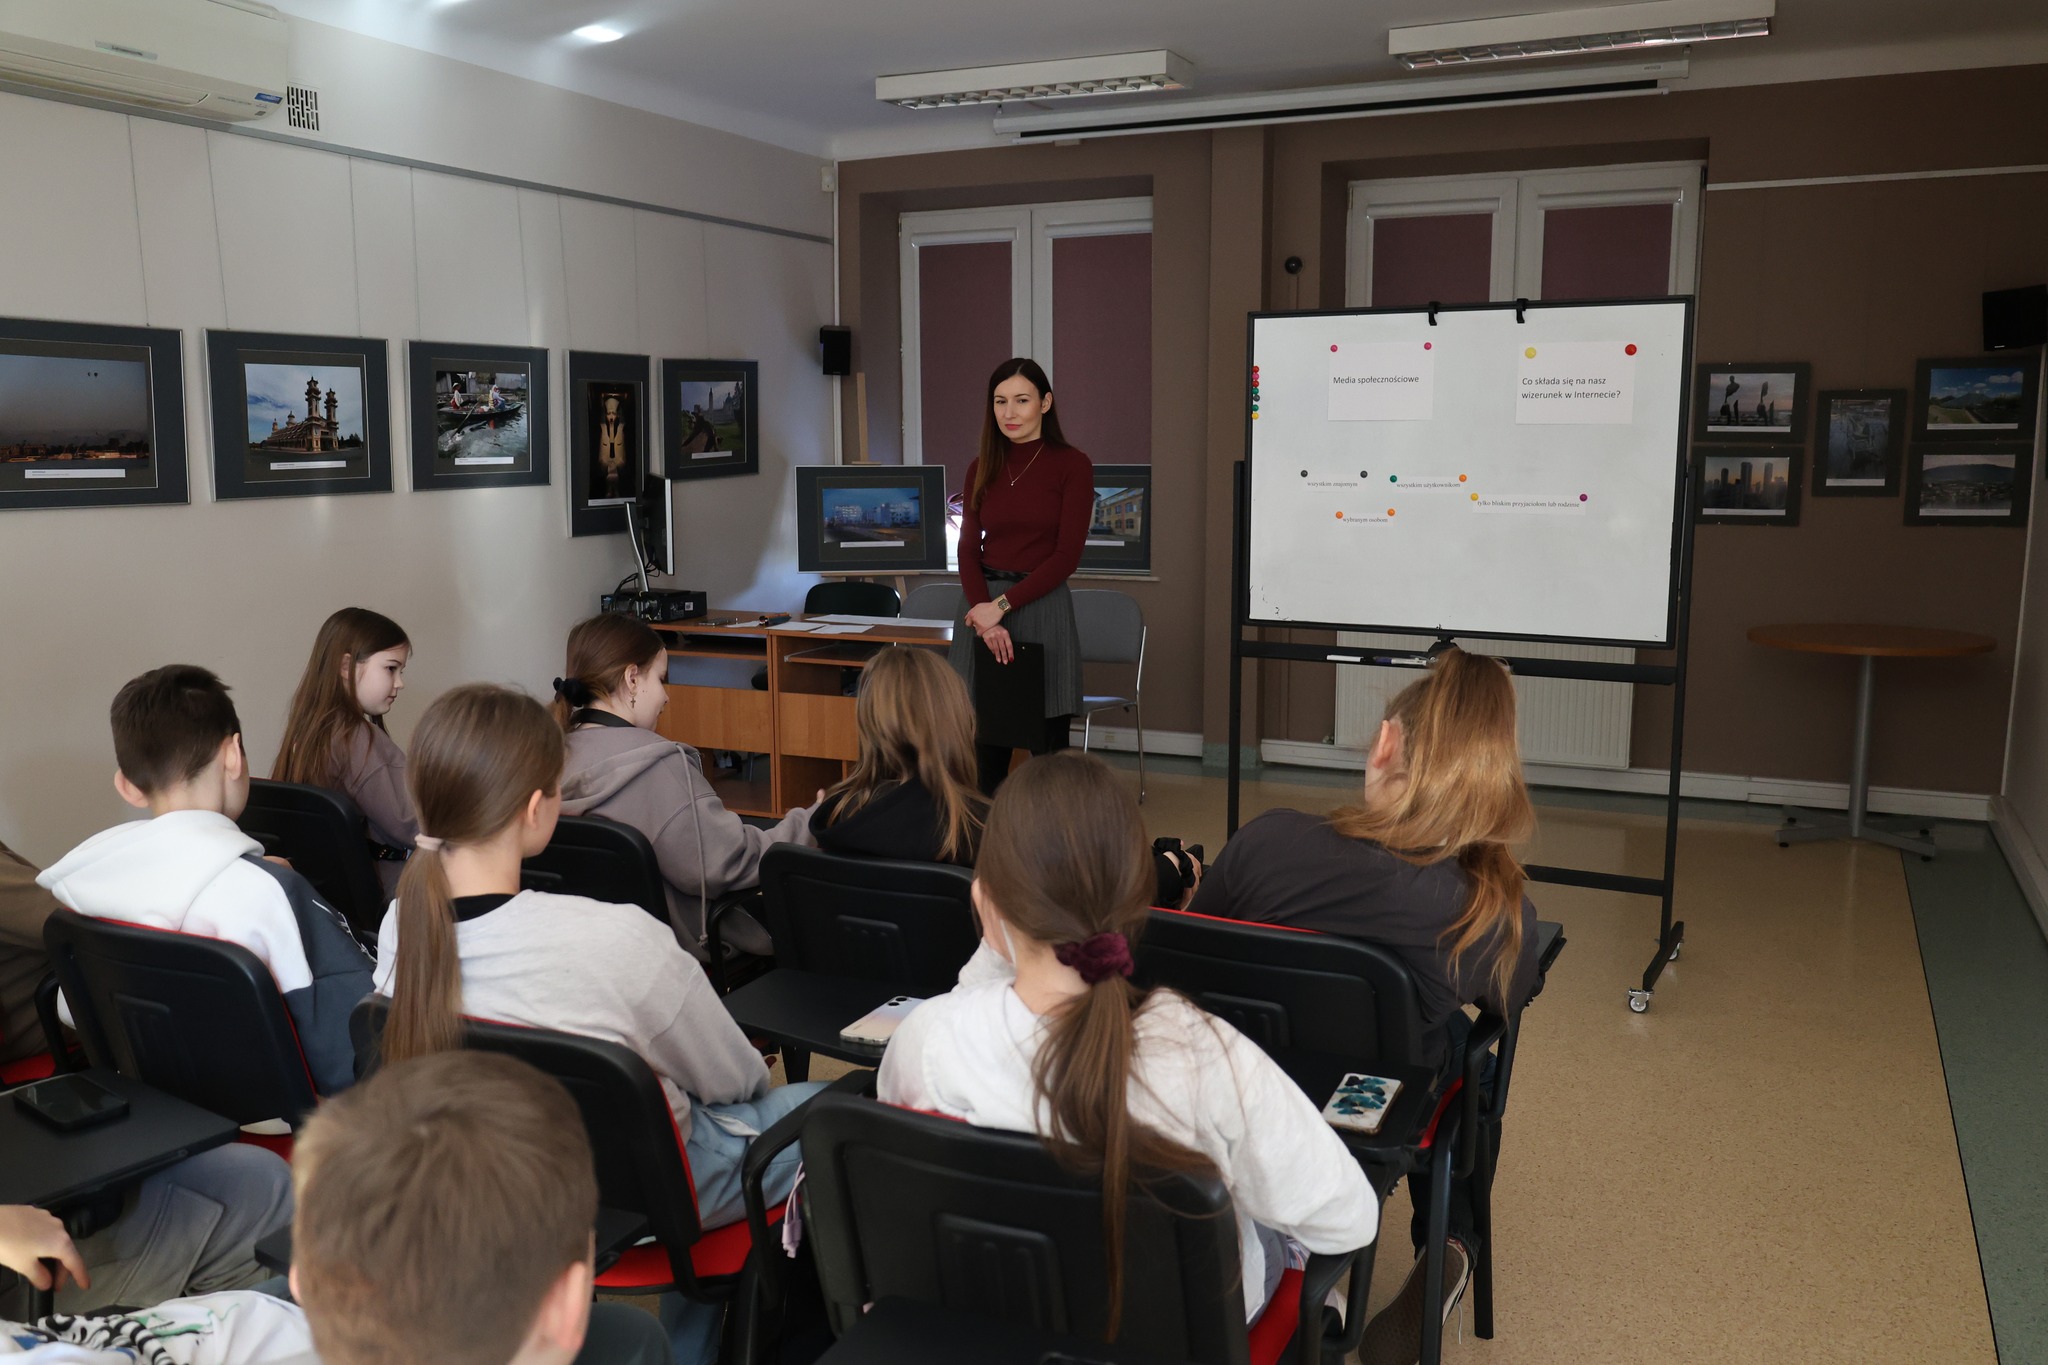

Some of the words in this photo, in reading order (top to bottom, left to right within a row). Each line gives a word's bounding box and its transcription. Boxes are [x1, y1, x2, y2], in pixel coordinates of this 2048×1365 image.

[1333, 376, 1356, 385] Media
[1358, 375, 1420, 385] społecznościowe
[1522, 377, 1533, 386] Co
[1535, 377, 1560, 386] składa
[1562, 377, 1574, 387] się
[1521, 390, 1563, 399] wizerunek
[1574, 389, 1621, 399] Internecie?
[1307, 481, 1332, 489] wszystkim
[1396, 482, 1423, 490] wszystkim
[1342, 516, 1368, 524] wybranym
